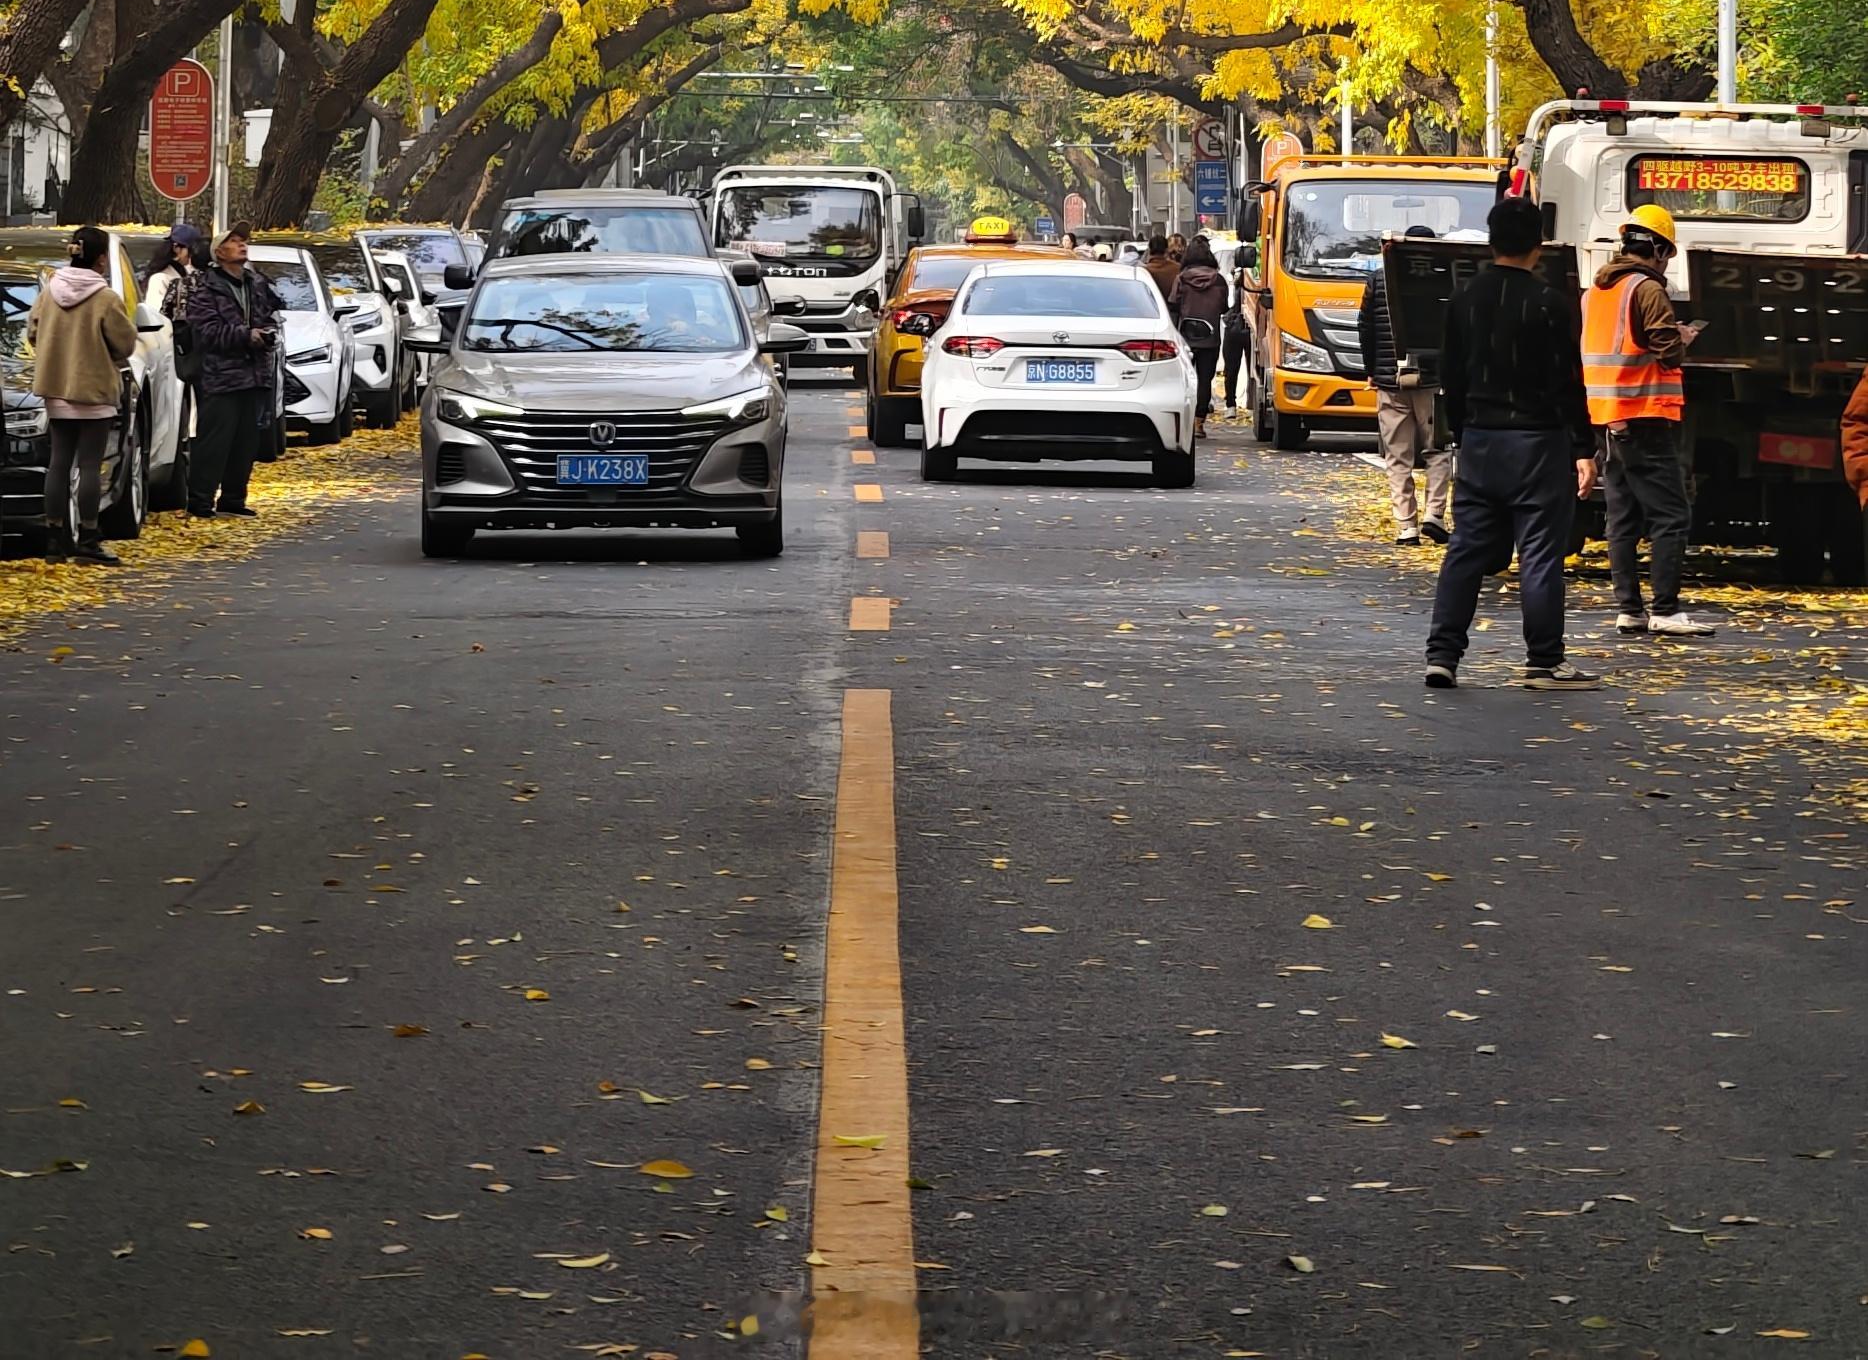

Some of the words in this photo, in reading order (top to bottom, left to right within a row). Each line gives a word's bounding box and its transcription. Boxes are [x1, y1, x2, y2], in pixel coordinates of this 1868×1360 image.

[174, 72, 191, 93] P
[1641, 172, 1796, 191] 13718529838
[979, 222, 1005, 230] TAXI
